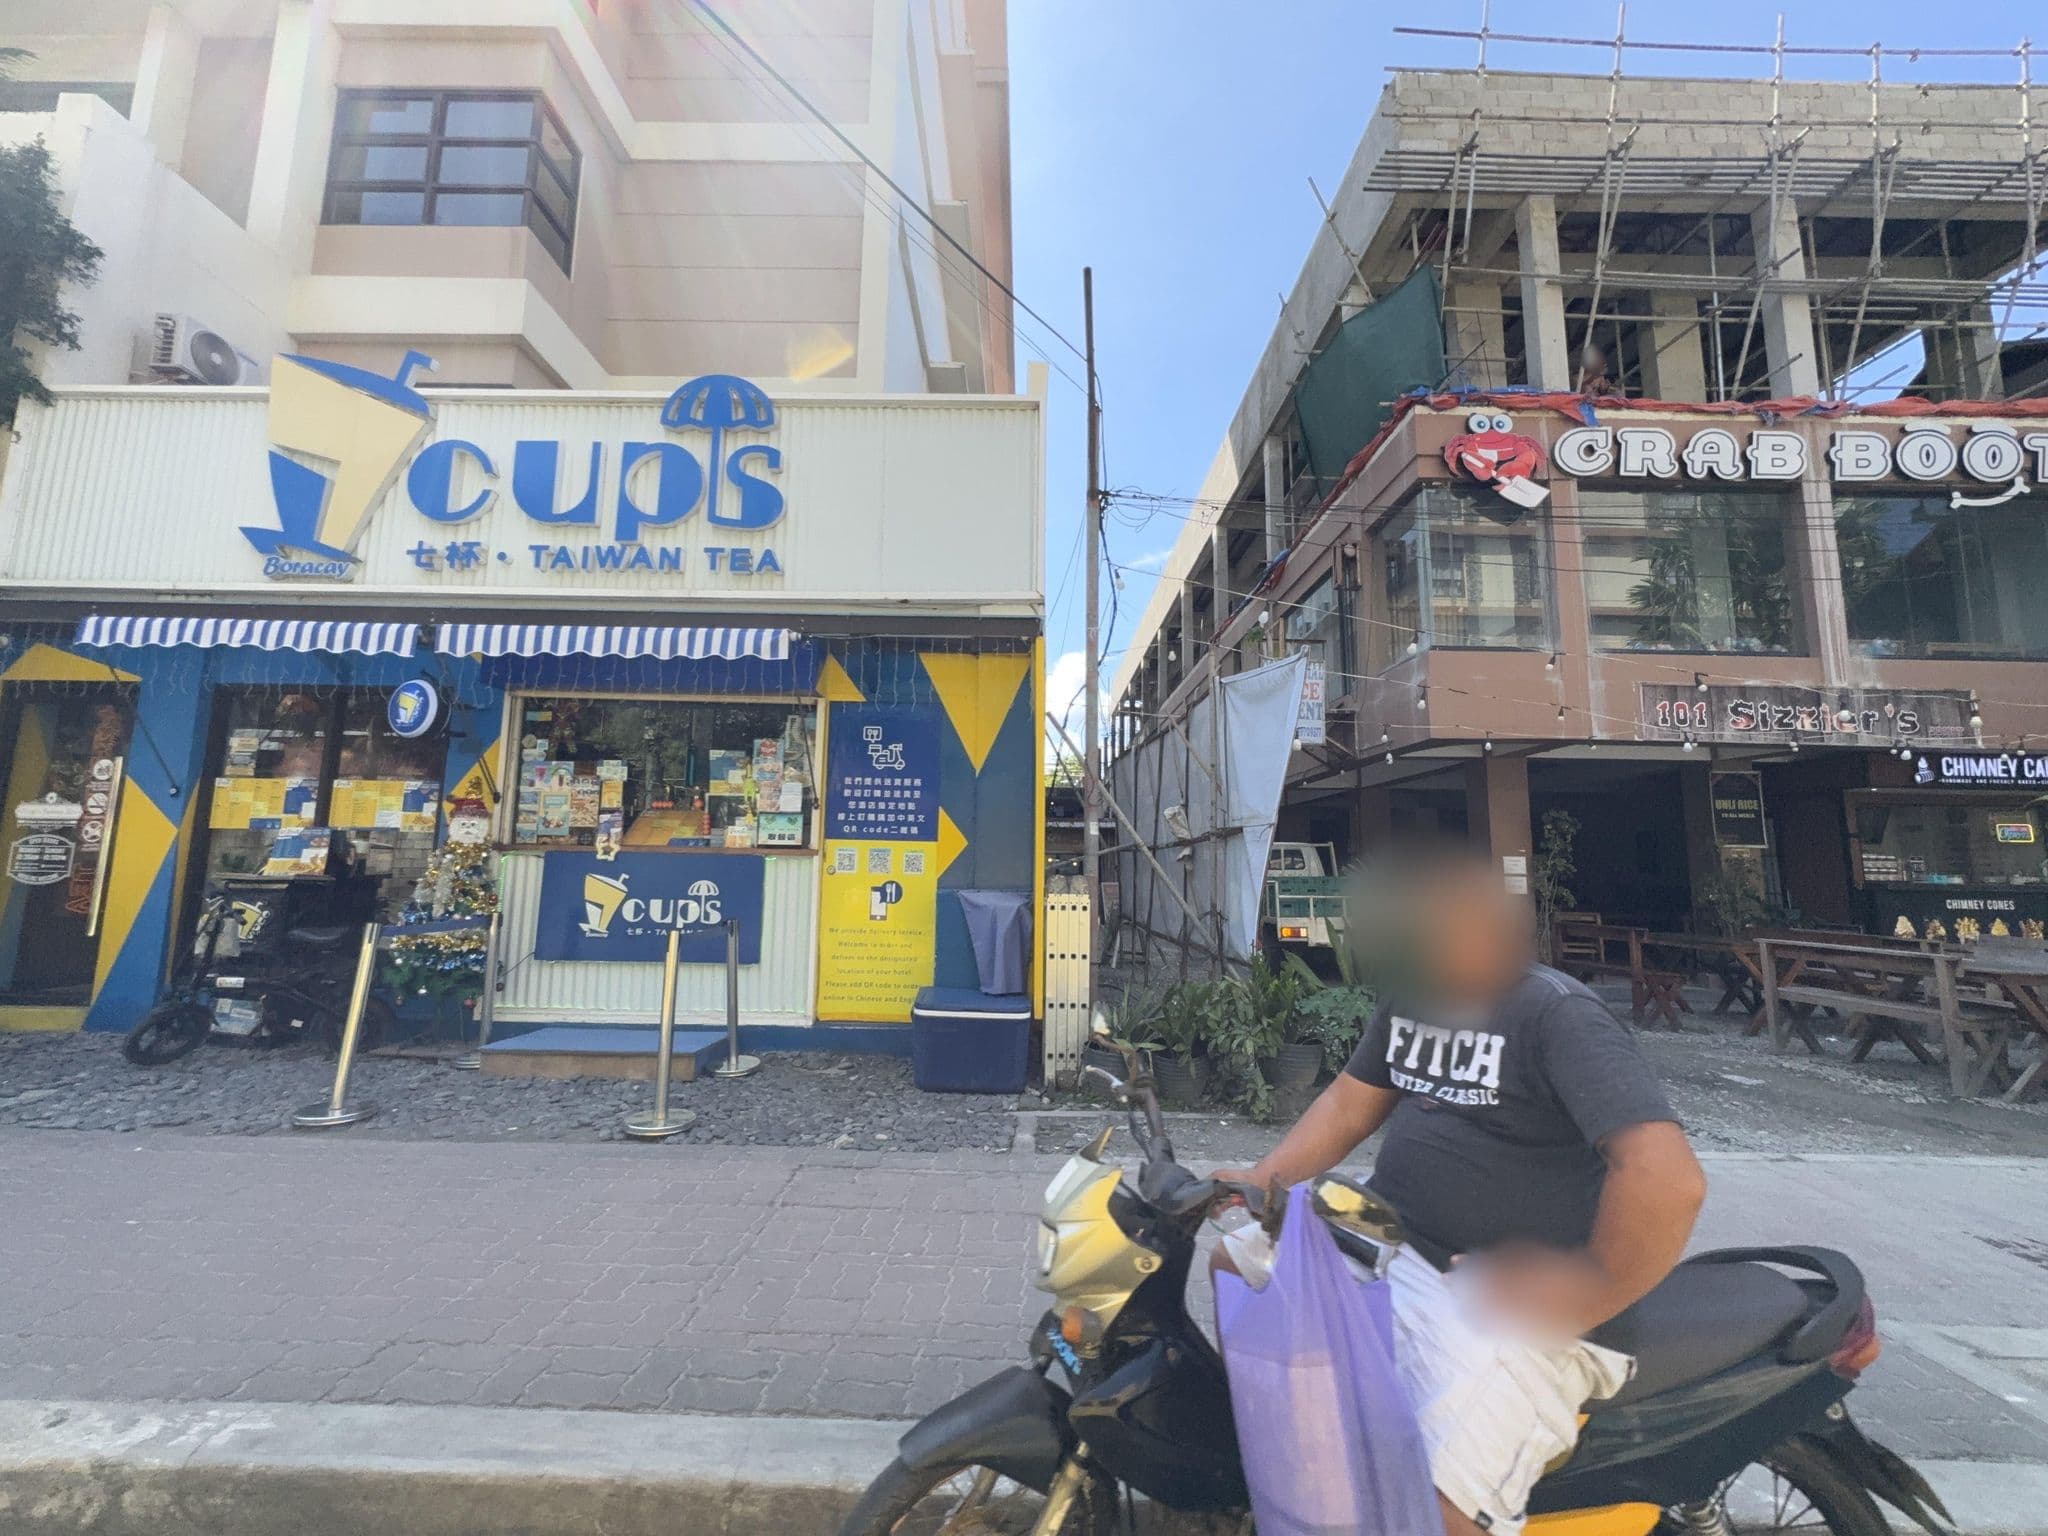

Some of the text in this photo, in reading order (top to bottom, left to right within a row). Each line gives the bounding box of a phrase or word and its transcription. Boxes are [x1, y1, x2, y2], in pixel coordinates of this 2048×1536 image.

[1554, 426, 1807, 481] CRAB
[263, 556, 350, 578] Boracay
[406, 541, 781, 574] 七杯 TAIWAN TEA
[1656, 700, 1708, 728] 101
[1727, 699, 1920, 734] Sizzler's
[1941, 756, 2048, 778] CHIMNEY CA
[1945, 899, 2015, 911] CHIMNEY CONES
[1385, 1015, 1506, 1089] FITCH
